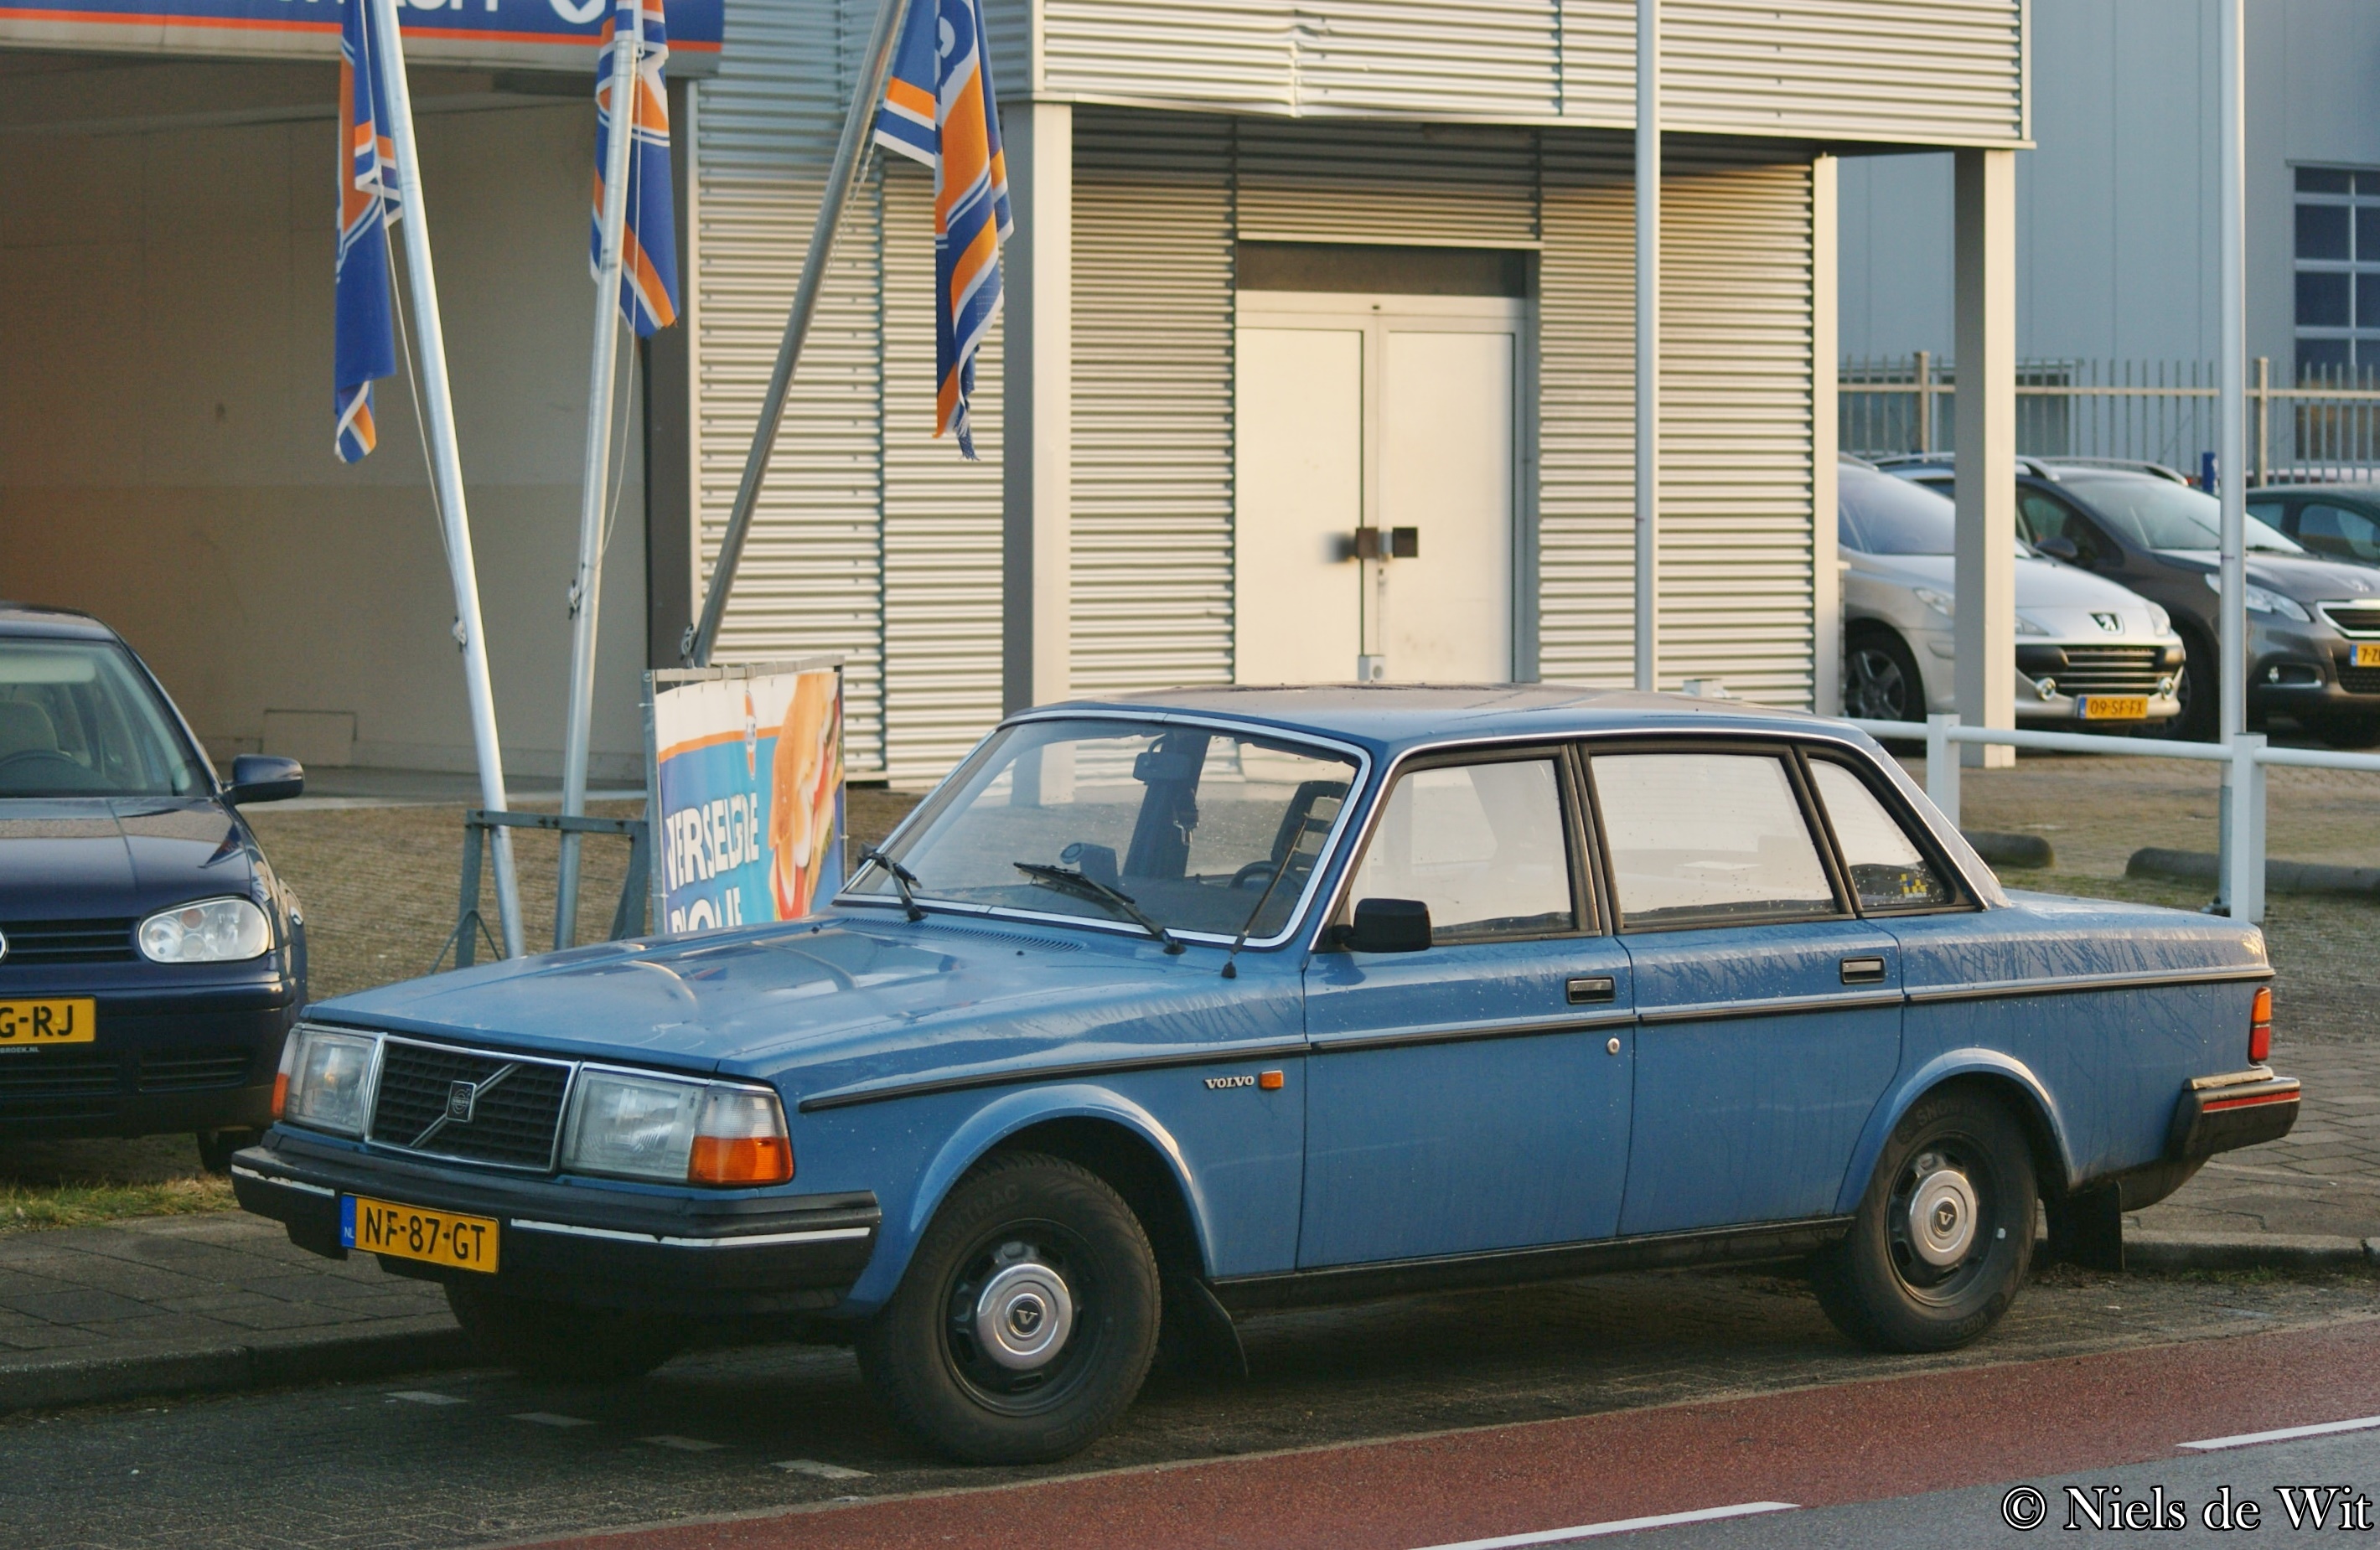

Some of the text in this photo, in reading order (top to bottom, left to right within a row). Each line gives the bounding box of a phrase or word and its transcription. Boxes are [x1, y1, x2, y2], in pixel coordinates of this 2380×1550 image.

[2362, 648, 2380, 663] 7-Z
[2090, 700, 2143, 715] 09-SF-FX
[0, 1005, 73, 1038] G-RJ
[1205, 1075, 1255, 1089] VOLVO
[344, 1227, 354, 1238] NL
[365, 1206, 485, 1262] NF-87-GT
[1016, 1309, 1038, 1325] V
